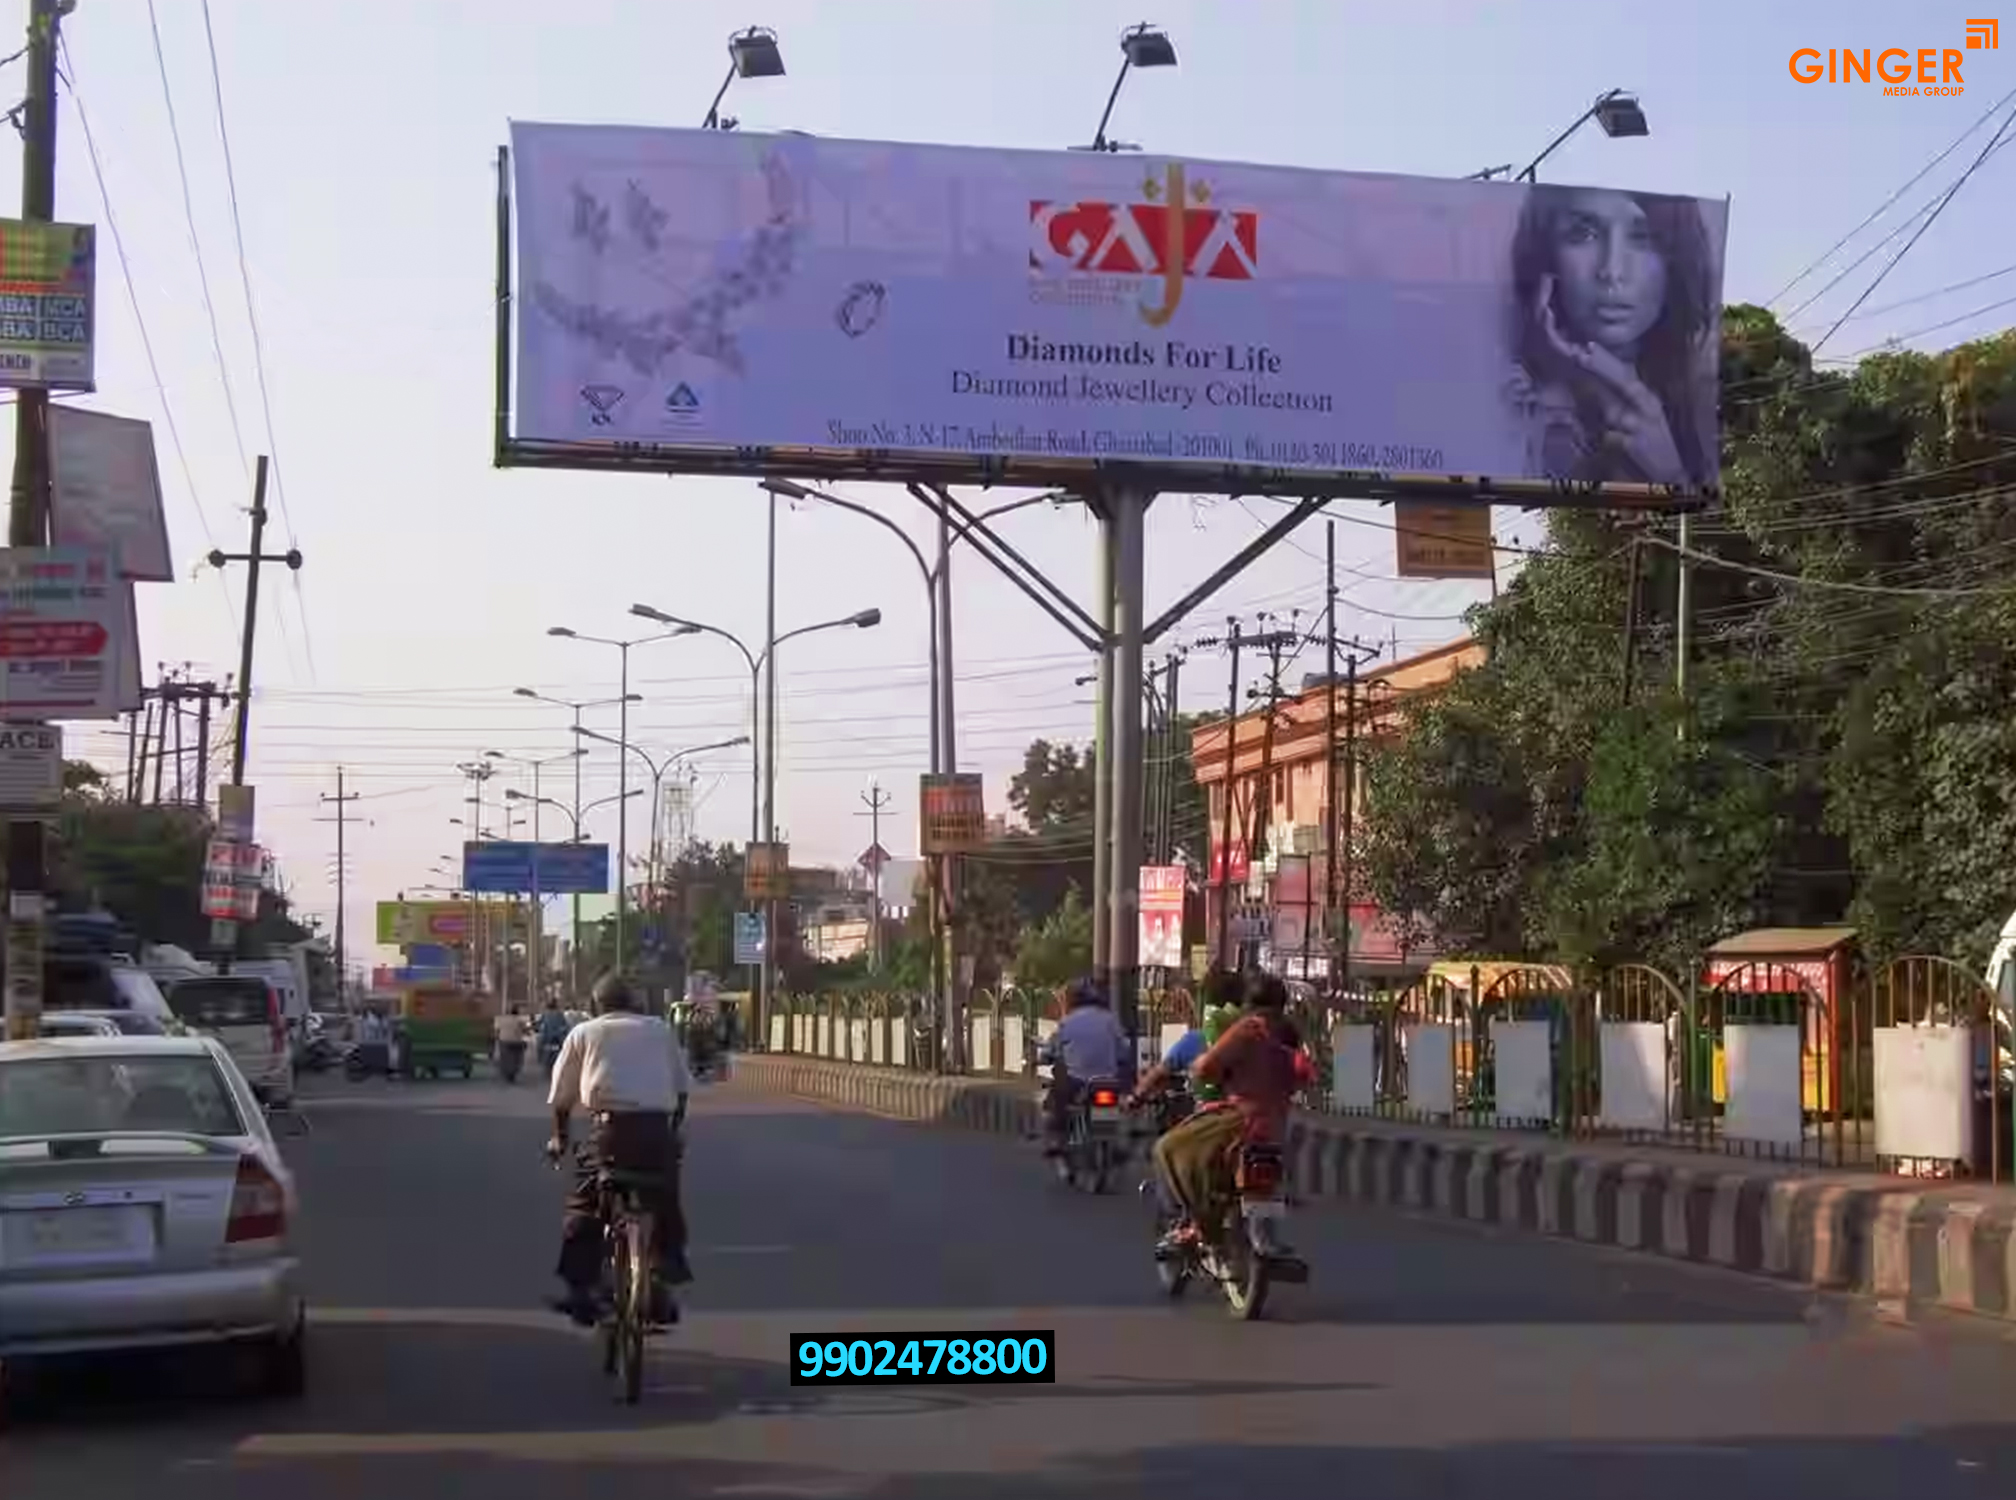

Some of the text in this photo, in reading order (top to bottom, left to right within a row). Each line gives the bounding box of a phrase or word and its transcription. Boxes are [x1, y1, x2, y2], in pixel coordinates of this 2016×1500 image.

[1006, 333, 1282, 374] Diamonds For Life
[951, 369, 1333, 412] Diamond Jewellery Collection
